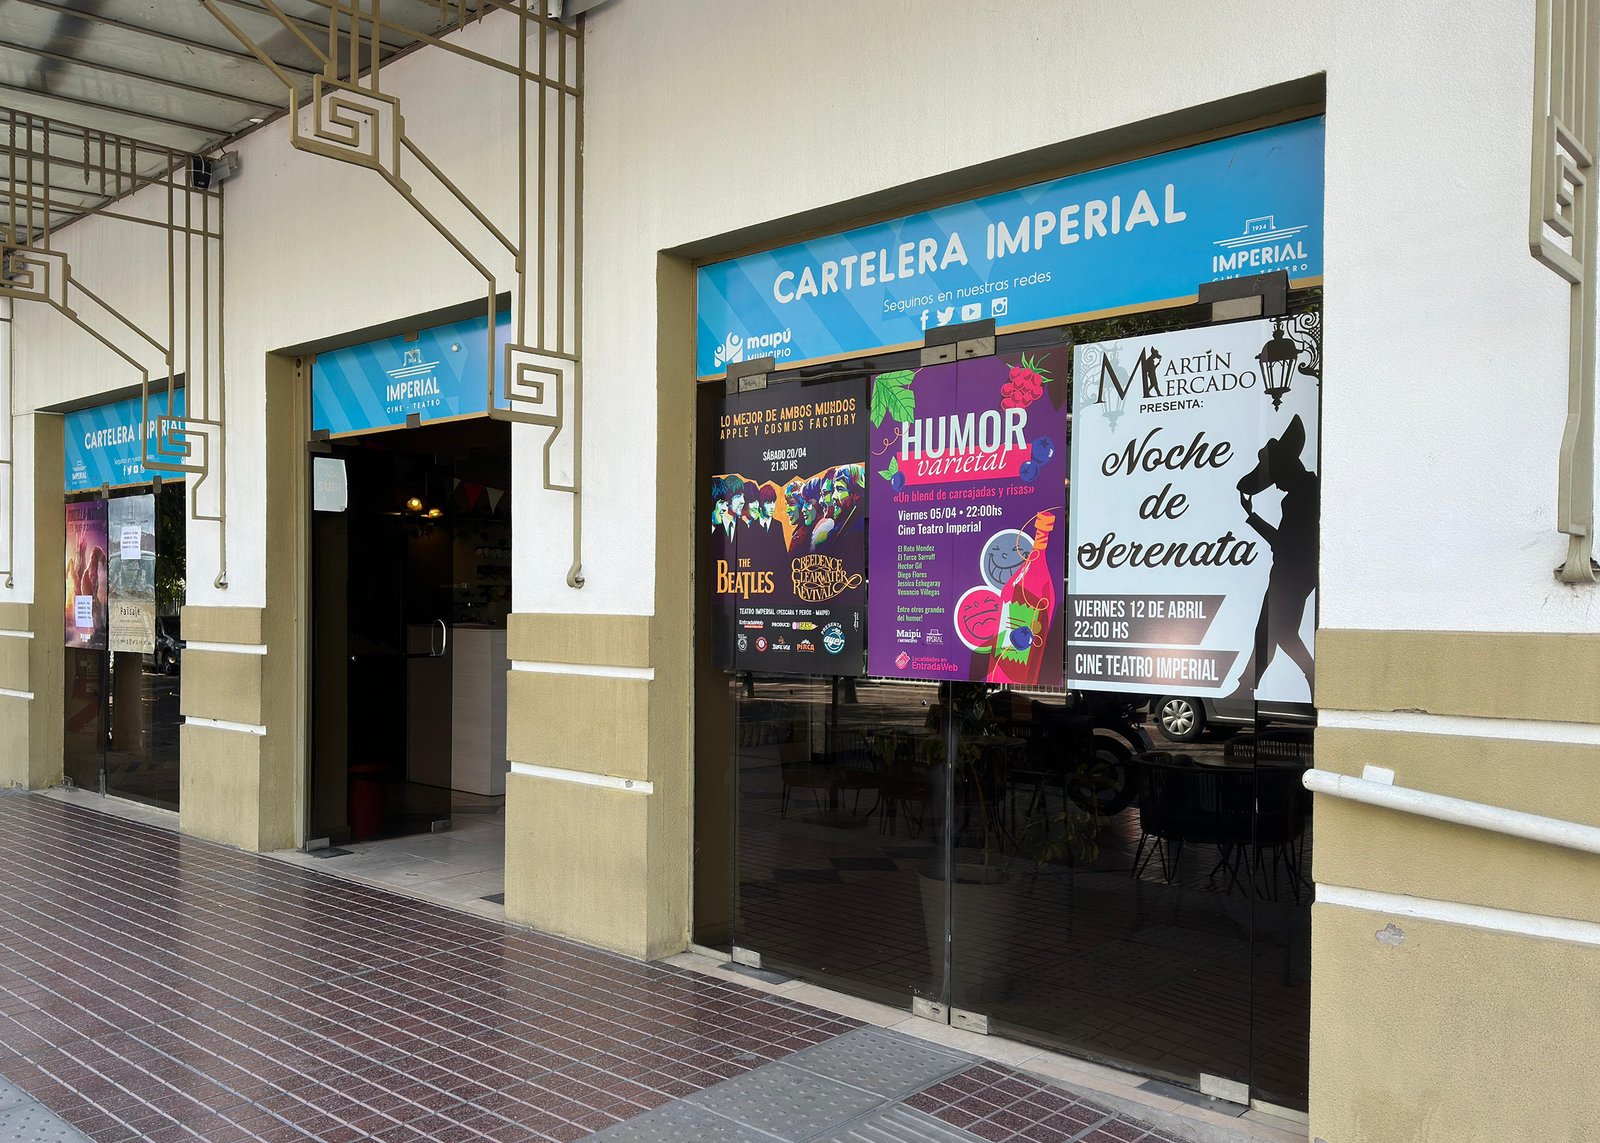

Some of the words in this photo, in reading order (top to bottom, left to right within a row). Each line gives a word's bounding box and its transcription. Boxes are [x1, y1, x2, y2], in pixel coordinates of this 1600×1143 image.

[773, 232, 968, 304] CARTELERA
[986, 183, 1187, 260] IMPERIAL
[1213, 241, 1308, 273] IMPERIAL
[883, 294, 934, 313] Seguinos
[938, 290, 953, 302] en
[956, 279, 1009, 299] nuestras
[1013, 271, 1052, 288] redes
[747, 327, 792, 350] maipú
[386, 376, 440, 402] IMPERIAL
[386, 404, 403, 413] CINE
[413, 398, 441, 409] TEATRO
[720, 414, 731, 428] LO
[733, 411, 763, 426] MEJOR
[765, 409, 777, 422] DE
[780, 404, 812, 420] AMBOS
[815, 397, 856, 416] MUNDOS
[1139, 399, 1204, 414] PRESENTA:
[84, 424, 135, 449] CARTELERA
[720, 426, 749, 440] APPLE
[754, 425, 759, 436] Y
[764, 419, 804, 434] COSMOS
[809, 413, 857, 429] FACTORY
[901, 407, 1028, 461] HUMOR
[762, 448, 786, 461] SÁBADO
[786, 447, 807, 459] 20/04
[917, 441, 1007, 477] varietal
[1101, 427, 1234, 477] Noche
[771, 461, 788, 472] 21.30
[789, 460, 798, 470] HS
[893, 491, 910, 503] «Un
[911, 489, 934, 502] blend
[936, 488, 947, 500] de
[950, 485, 996, 502] carcajadas
[998, 487, 1004, 498] y
[1006, 483, 1035, 496] risas»
[1138, 482, 1190, 520] de
[898, 510, 928, 521] Viernes
[930, 507, 957, 520] 05/04
[966, 505, 1003, 518] 22:00hs
[898, 524, 916, 536] Cine
[917, 523, 944, 535] Teatro
[946, 521, 982, 535] Imperial
[897, 545, 903, 553] El
[1077, 531, 1259, 571] Serenata
[738, 559, 751, 568] THE
[791, 554, 843, 573] CREEDENCE
[716, 559, 775, 600] BEATLES
[791, 569, 848, 584] CLEARWATER
[1074, 599, 1125, 618] VIERNES
[1129, 600, 1145, 618] 12
[1148, 601, 1165, 618] DE
[1168, 601, 1207, 619] ABRIL
[896, 628, 922, 639] Maipú
[1074, 620, 1109, 638] 22:00
[1112, 621, 1129, 639] HS
[911, 661, 959, 672] EntradaWeb
[1075, 653, 1103, 675] CINE
[1106, 655, 1152, 678] TEATRO
[1156, 657, 1219, 681] IMPERIAL
